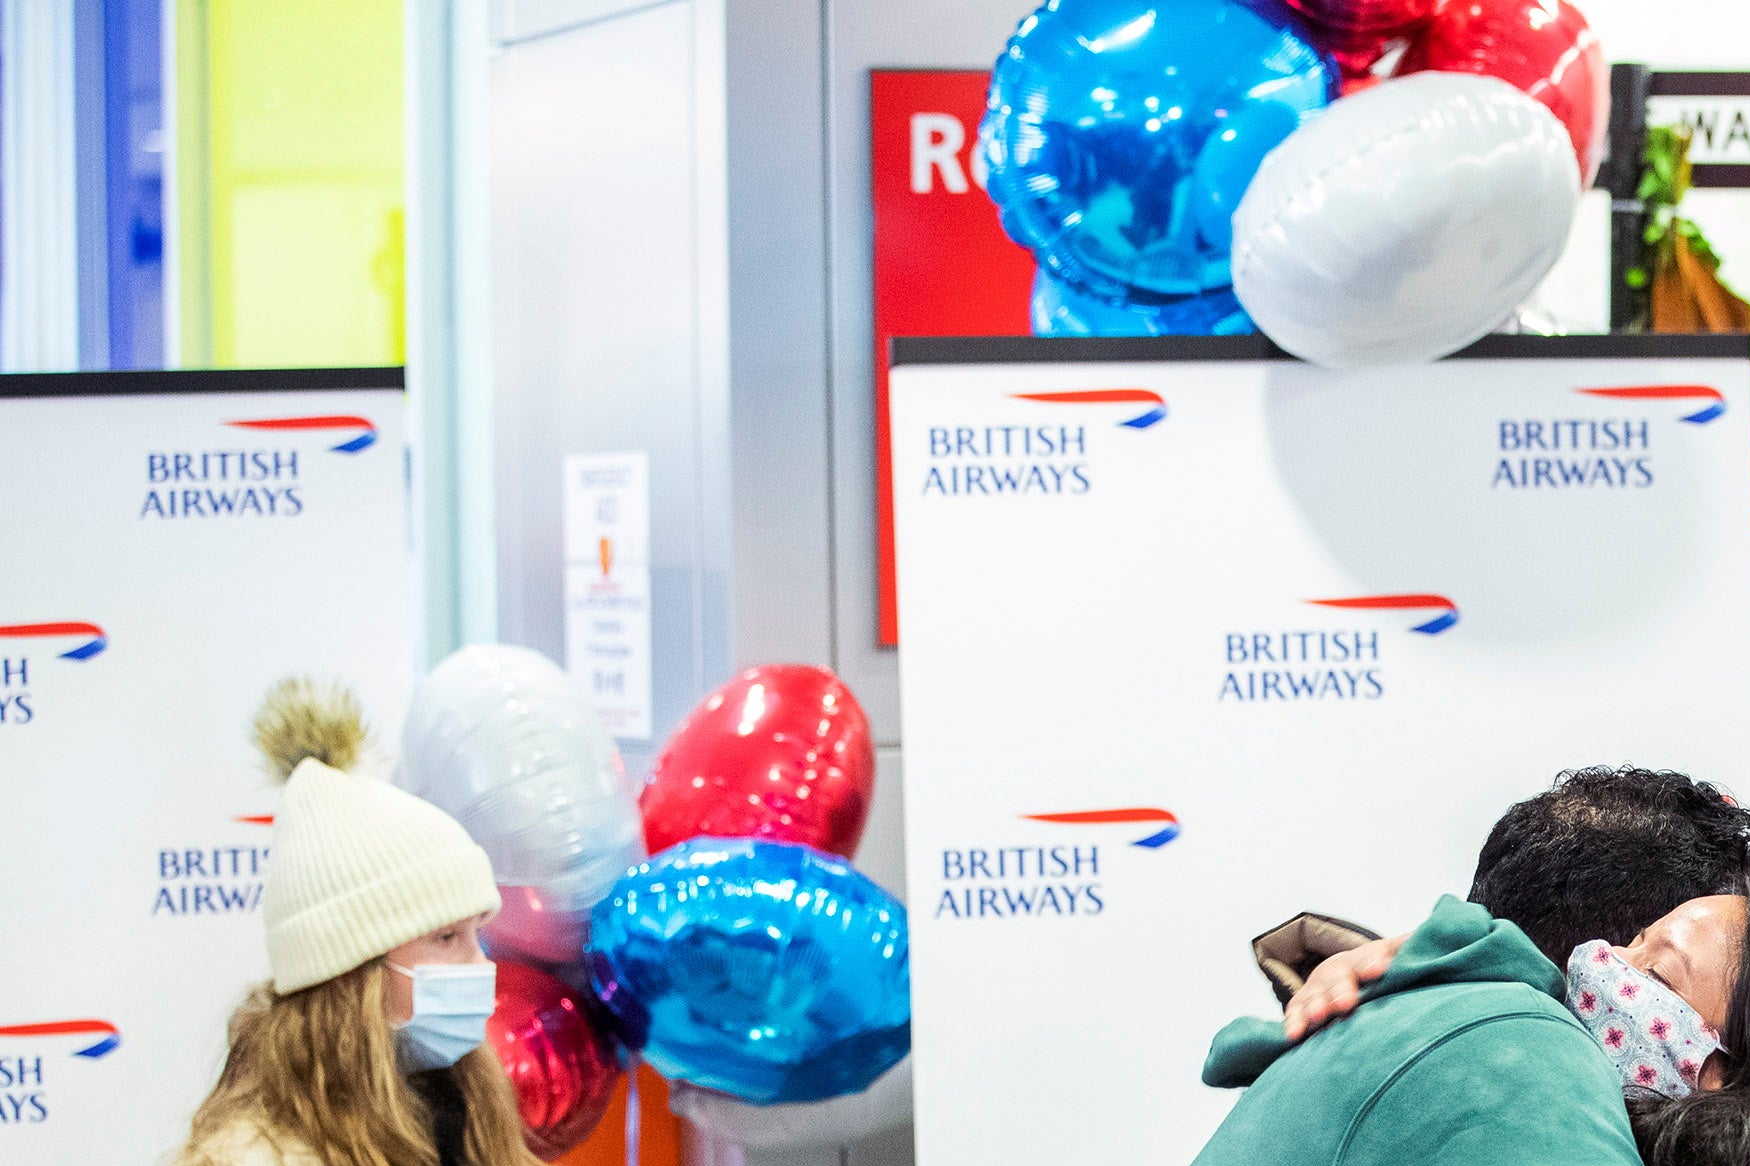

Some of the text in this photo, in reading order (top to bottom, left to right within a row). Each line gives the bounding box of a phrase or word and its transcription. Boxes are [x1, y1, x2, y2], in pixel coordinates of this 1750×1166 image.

[909, 112, 989, 194] R
[929, 425, 1086, 459] BRITISH
[1498, 419, 1650, 452] BRITISH
[147, 450, 299, 484] BRITISH
[922, 463, 1092, 497] AIRWAYS
[1491, 457, 1655, 490] AIRWAYS
[140, 487, 304, 520] AIRWAYS
[1226, 630, 1381, 665] BRITISH
[1218, 670, 1385, 703] AIRWAYS
[158, 846, 270, 881] BRITI
[942, 845, 1100, 882] BRITISH
[935, 884, 1104, 920] AIRWAYS
